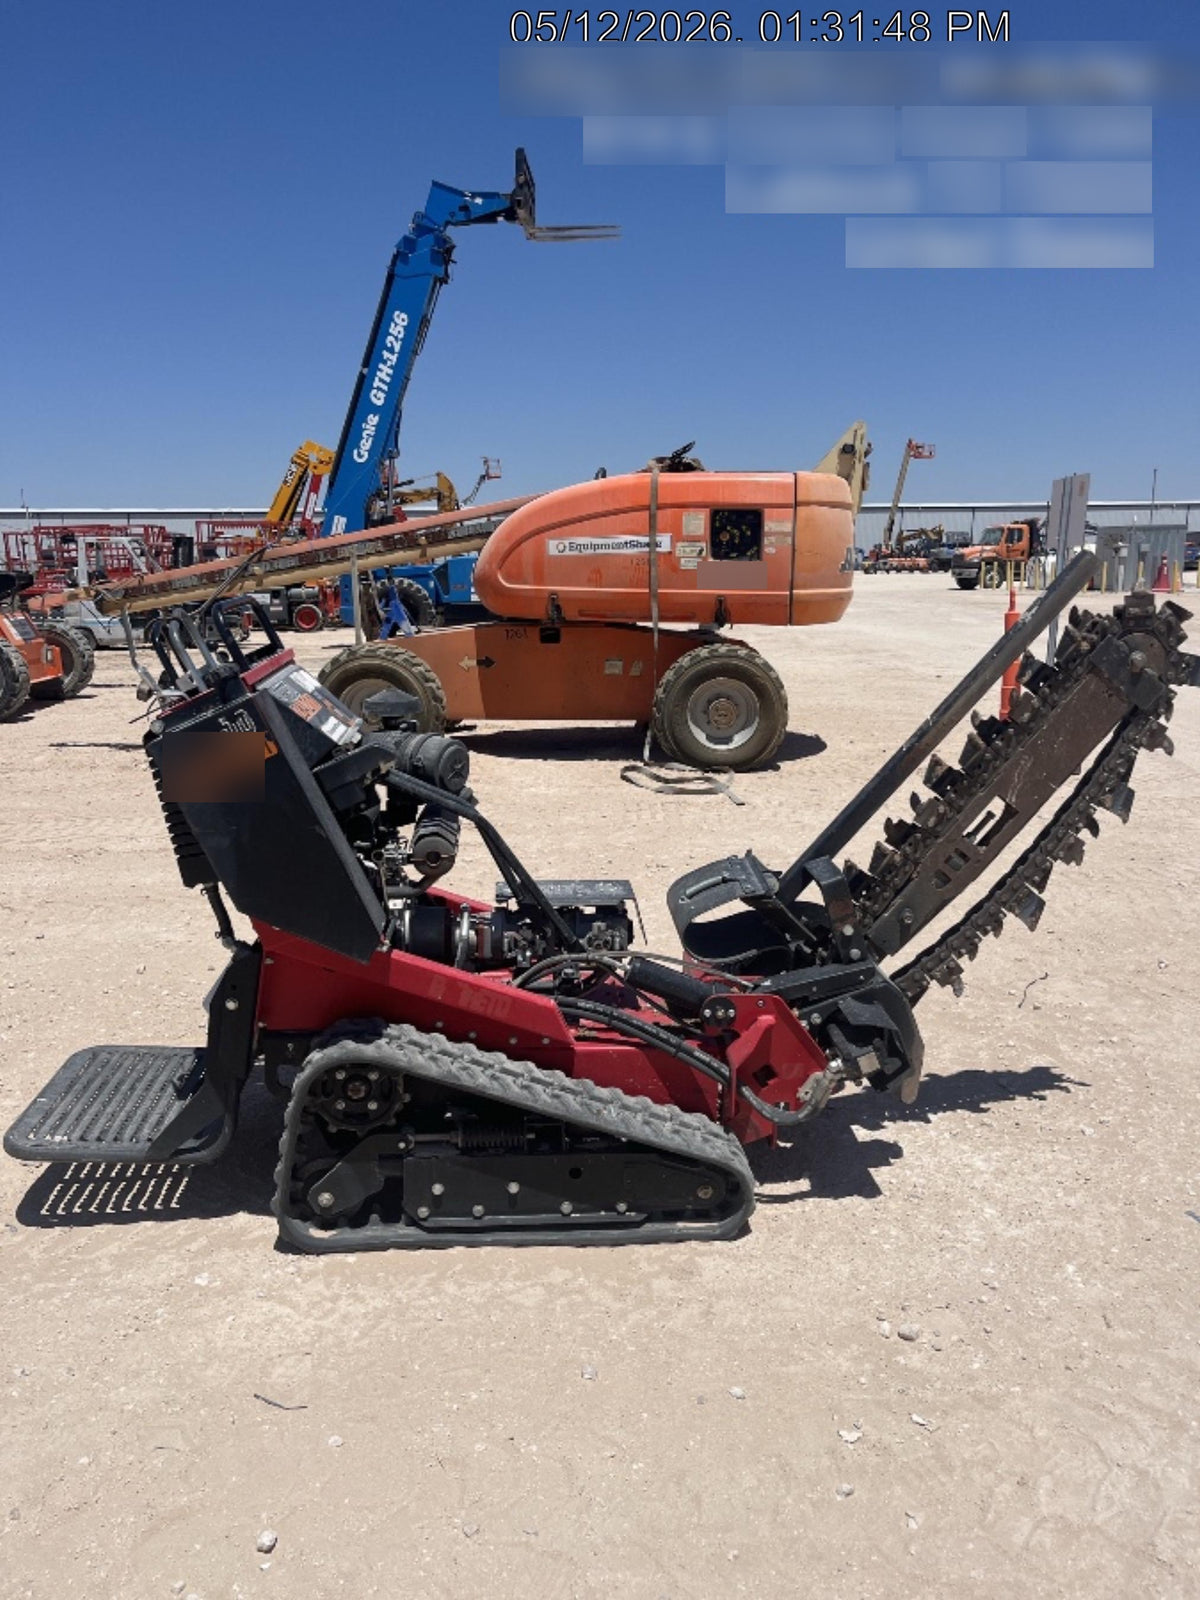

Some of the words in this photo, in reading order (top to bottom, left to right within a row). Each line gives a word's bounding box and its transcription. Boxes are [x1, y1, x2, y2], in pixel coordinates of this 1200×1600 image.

[353, 414, 379, 463] Genie
[369, 310, 409, 406] GTH-1256
[567, 539, 663, 553] EquipmentShae
